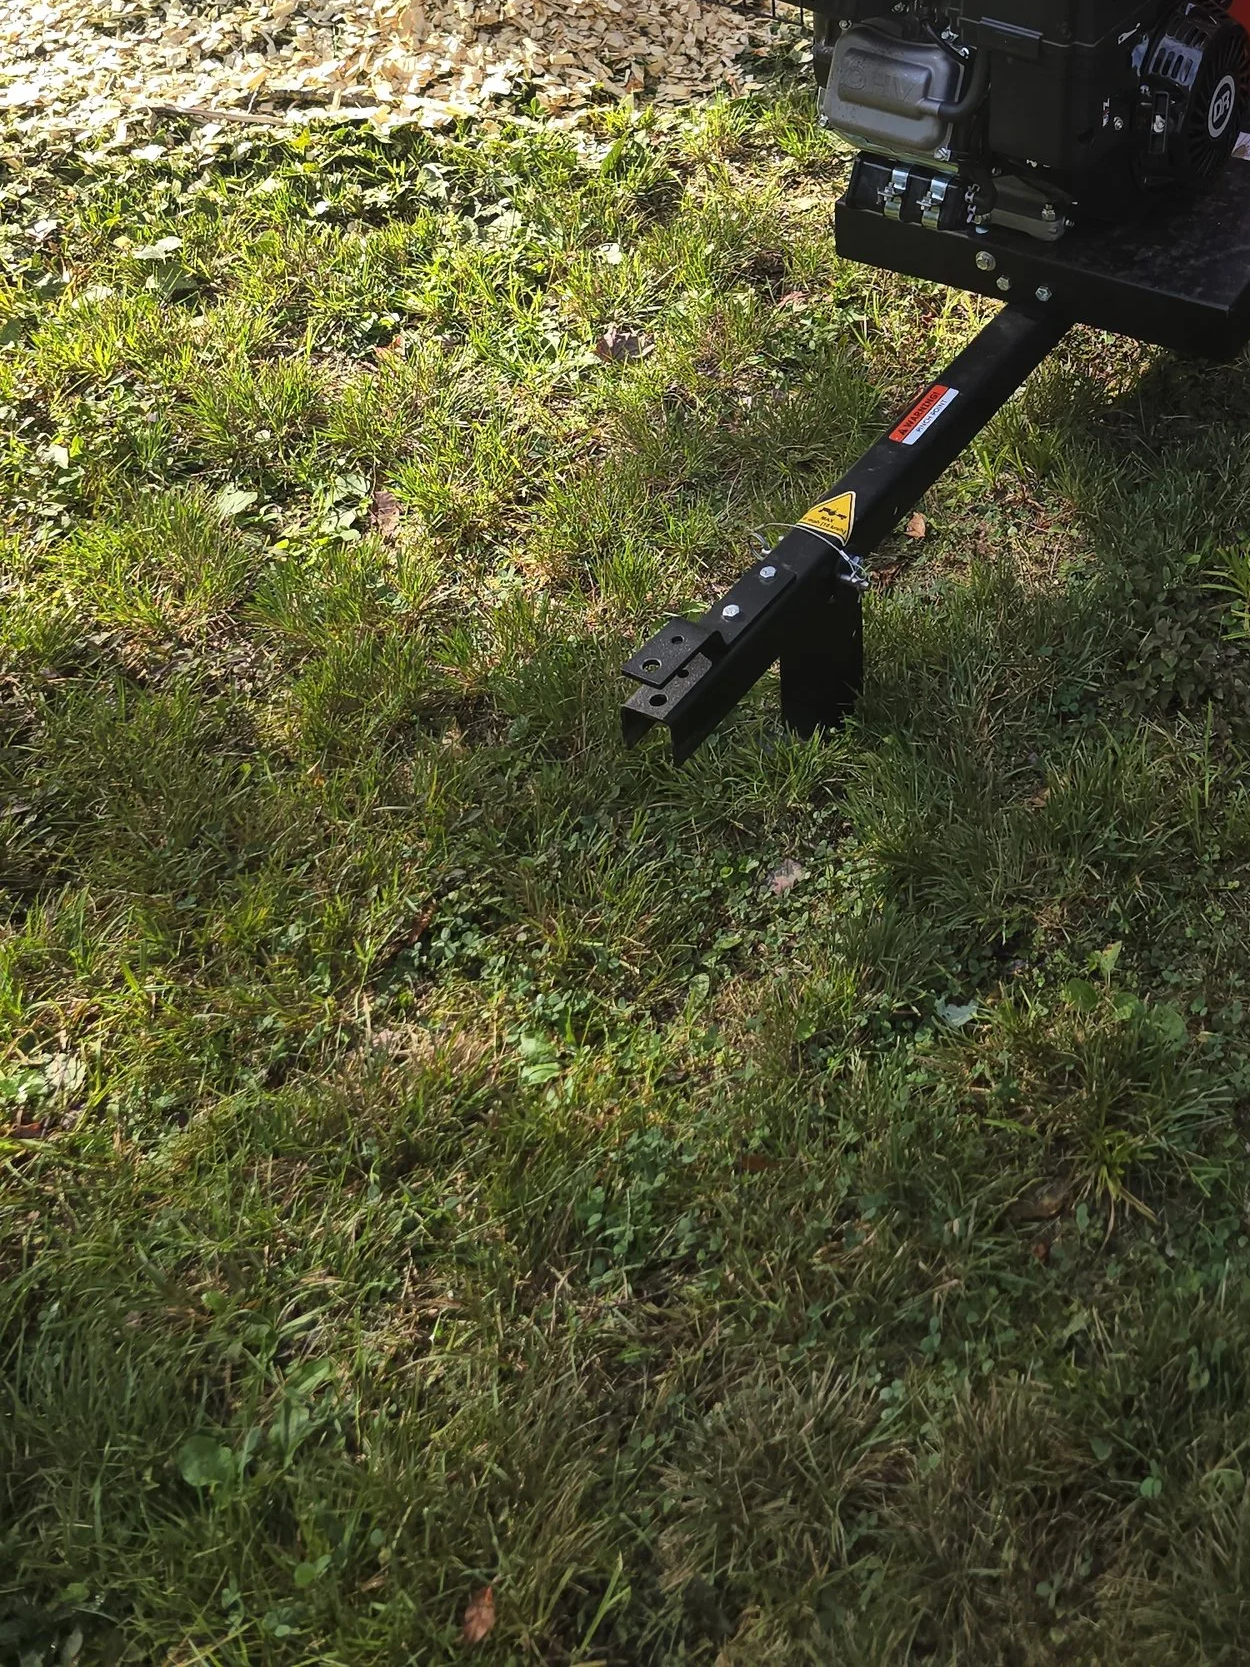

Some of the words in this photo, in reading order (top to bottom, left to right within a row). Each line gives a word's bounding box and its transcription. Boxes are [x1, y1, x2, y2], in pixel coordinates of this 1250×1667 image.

[1213, 90, 1230, 123] DR
[905, 391, 939, 427] WARNING!
[916, 415, 932, 432] PINCH
[932, 399, 947, 415] POINT
[821, 515, 835, 523] MAX
